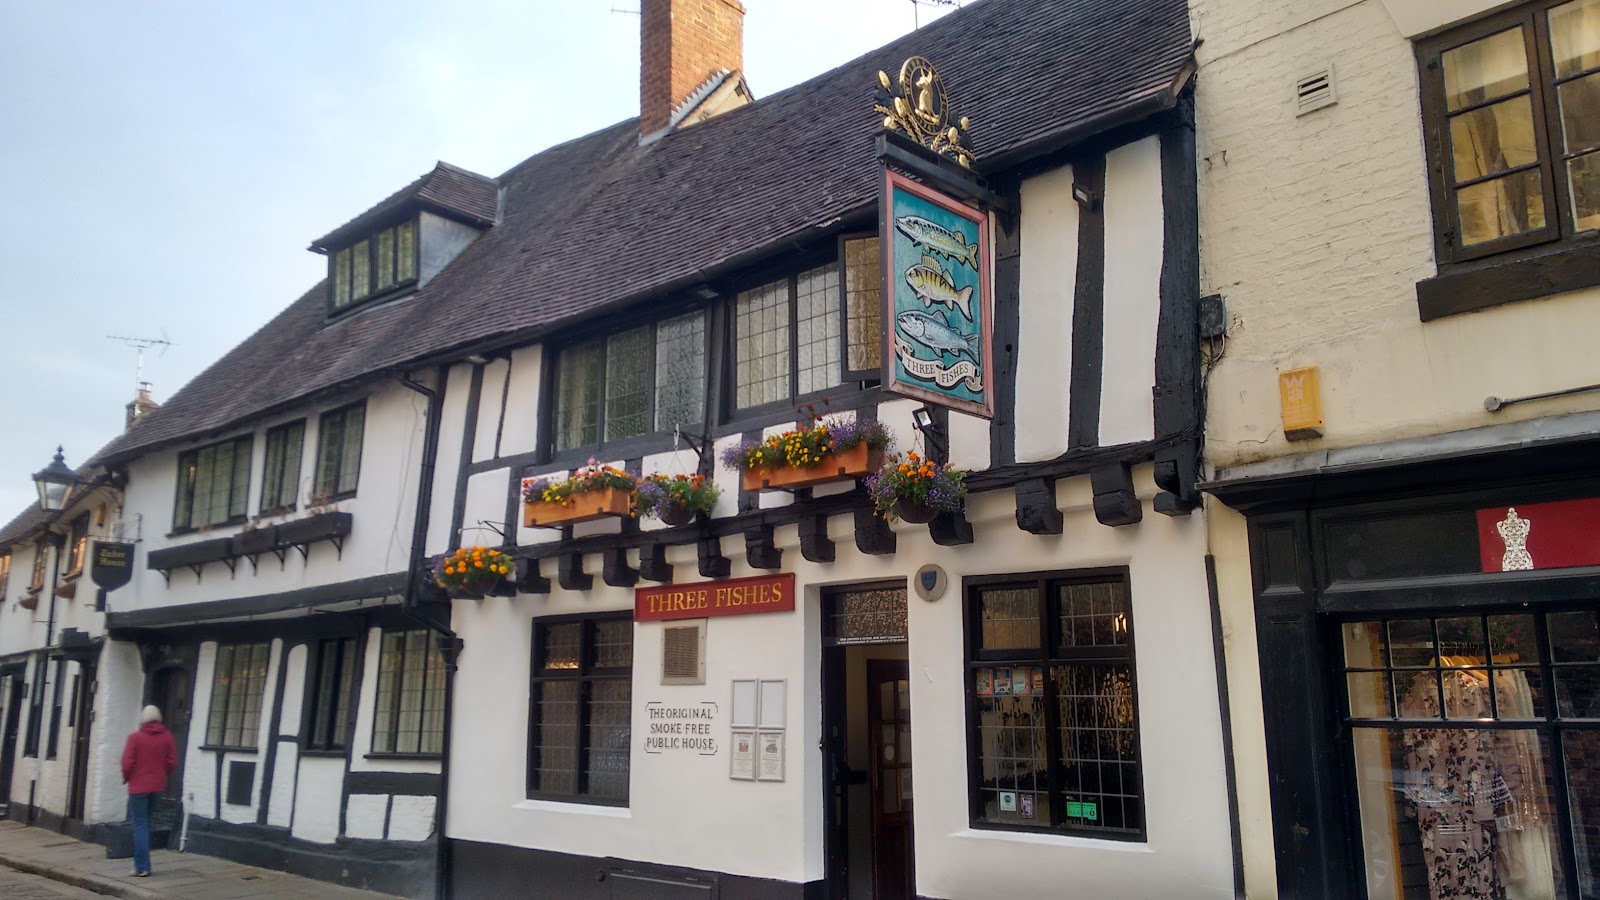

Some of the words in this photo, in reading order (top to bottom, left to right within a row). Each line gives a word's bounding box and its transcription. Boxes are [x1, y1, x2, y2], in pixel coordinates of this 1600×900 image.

[906, 357, 936, 375] THREE
[941, 363, 969, 383] FISHES
[646, 590, 708, 613] THREE
[715, 582, 782, 608] FISHES
[648, 708, 665, 719] THE
[665, 708, 713, 719] ORIGINAL
[646, 737, 680, 748] PUBLIC
[682, 737, 714, 750] HOUSE
